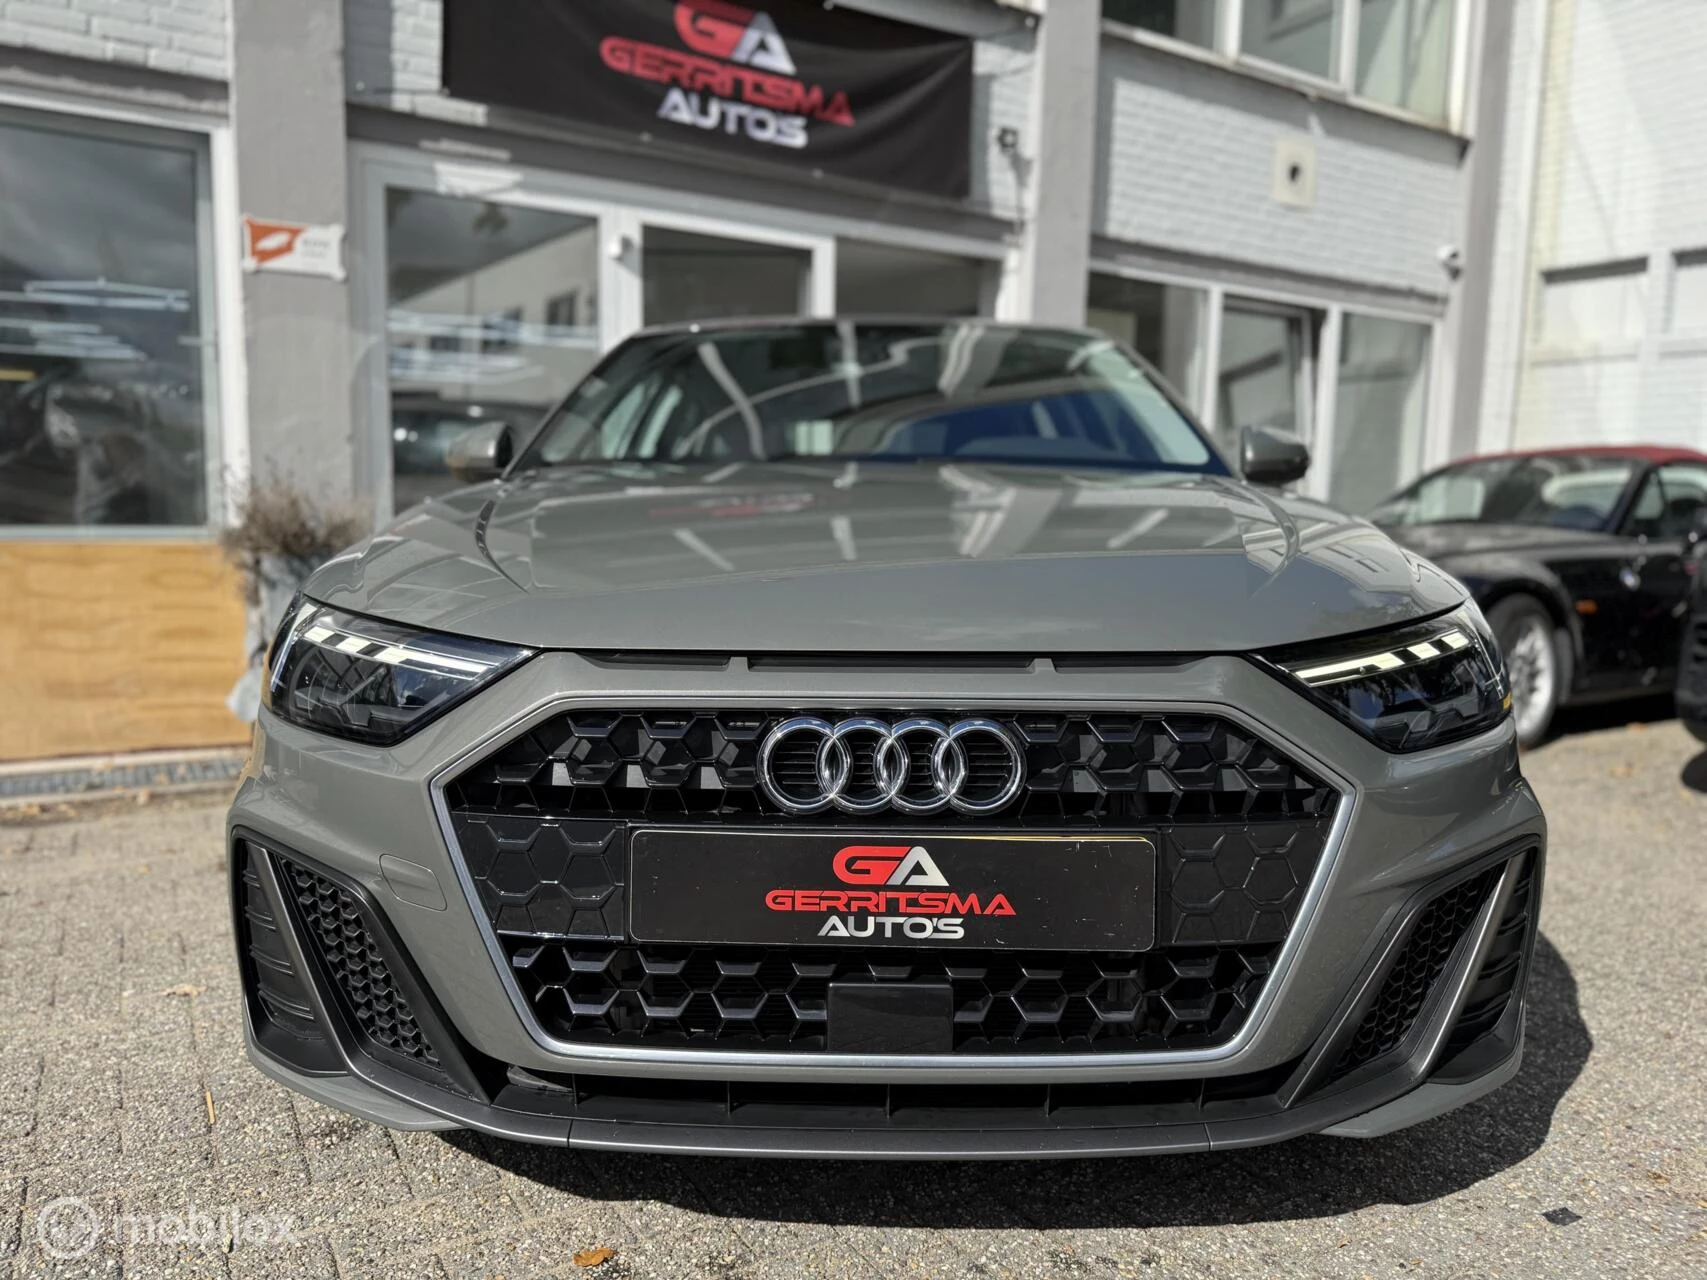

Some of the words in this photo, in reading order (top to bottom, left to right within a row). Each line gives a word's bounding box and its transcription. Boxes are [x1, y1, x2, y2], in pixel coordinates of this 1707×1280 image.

[673, 0, 797, 75] GA
[600, 36, 855, 127] GERRITSMA
[832, 845, 950, 887] GA
[765, 889, 1017, 916] GERRITSMA
[817, 915, 965, 939] AUTO'S
